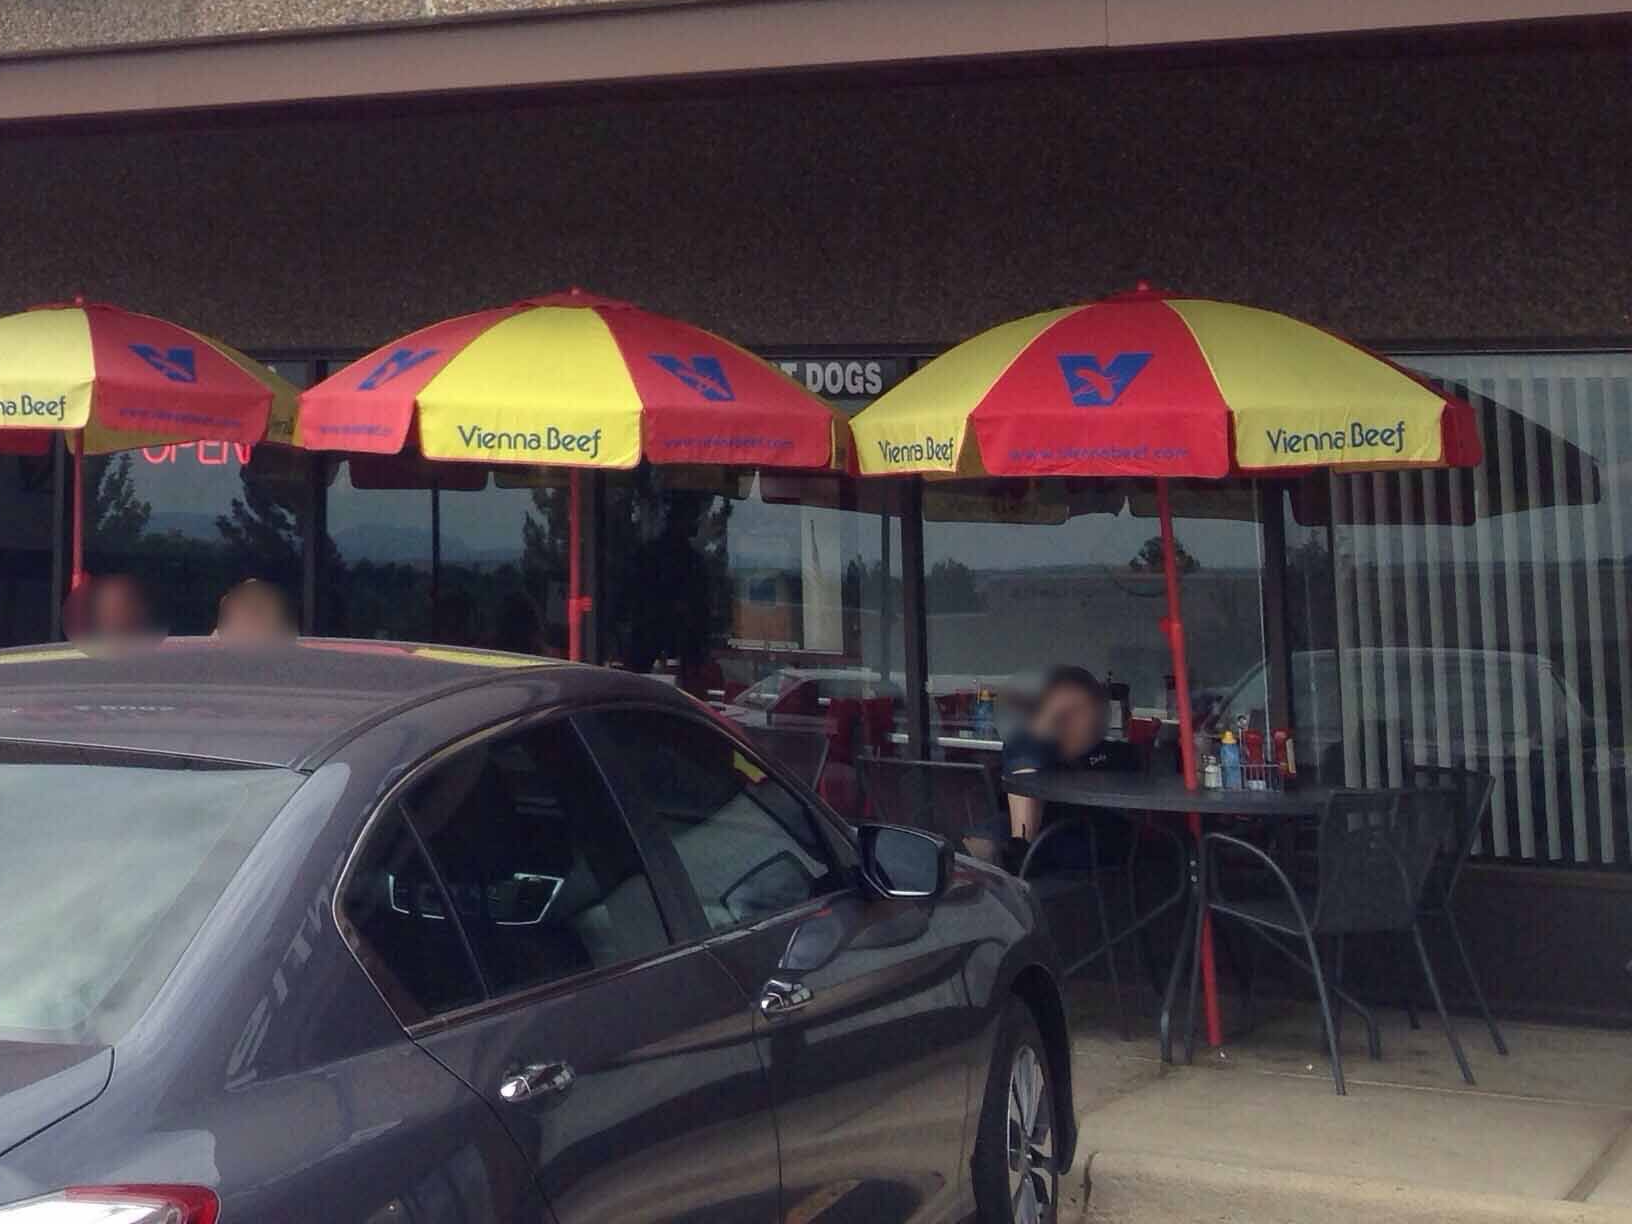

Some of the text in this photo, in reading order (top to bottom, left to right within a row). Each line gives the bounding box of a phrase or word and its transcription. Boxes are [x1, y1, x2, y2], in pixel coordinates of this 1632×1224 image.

[805, 361, 883, 394] DOGS
[20, 394, 66, 421] Beef
[457, 425, 602, 458] Vienna Beef
[878, 436, 954, 465] Vienna Beef
[1266, 420, 1405, 454] Vienna Beef
